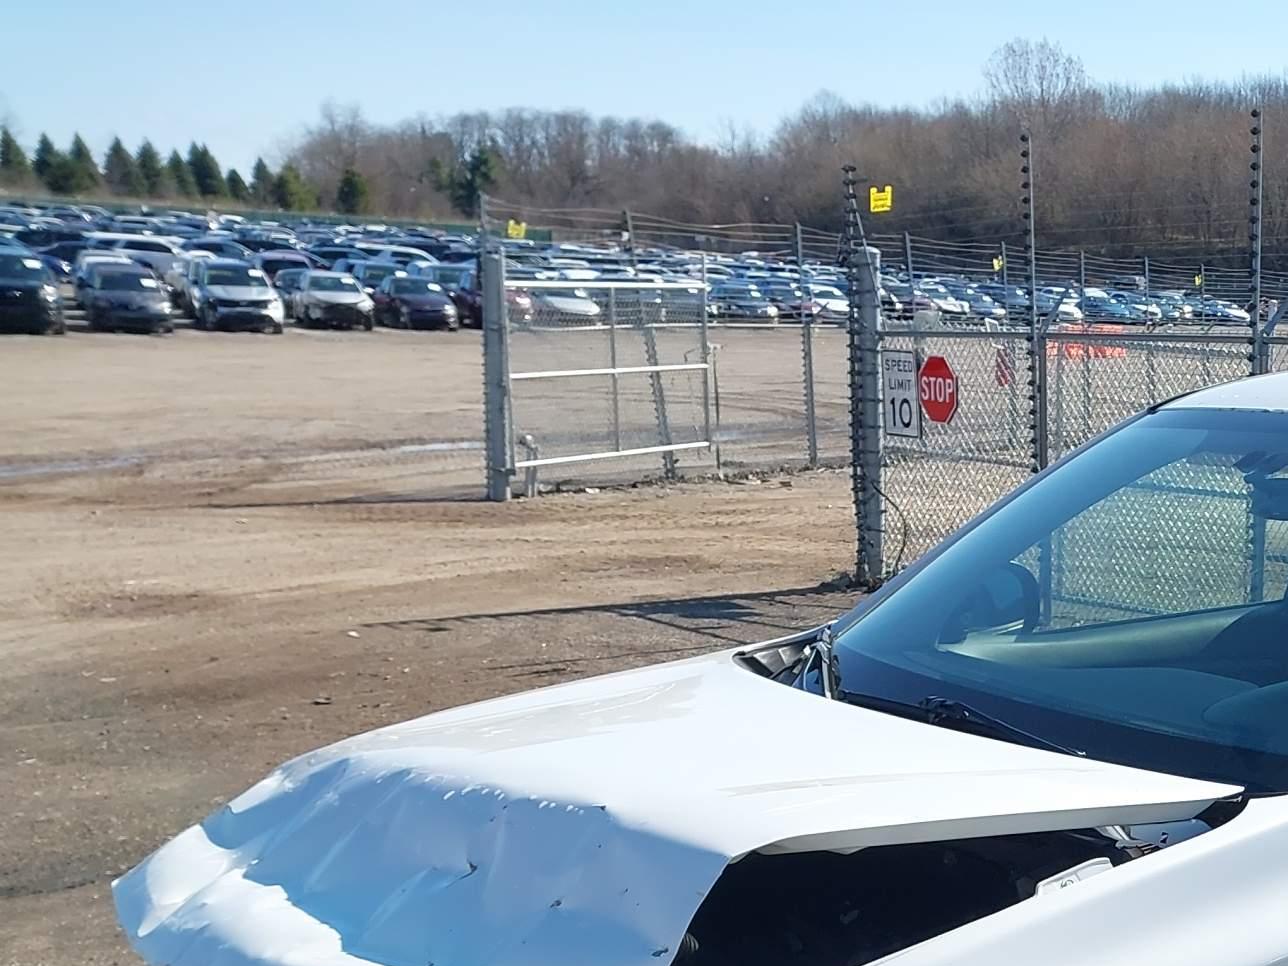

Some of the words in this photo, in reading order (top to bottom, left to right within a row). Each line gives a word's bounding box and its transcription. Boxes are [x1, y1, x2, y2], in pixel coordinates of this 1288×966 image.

[884, 359, 913, 373] SPEED
[888, 378, 912, 392] LIMIT
[921, 375, 954, 403] STOP
[890, 397, 912, 428] 10
